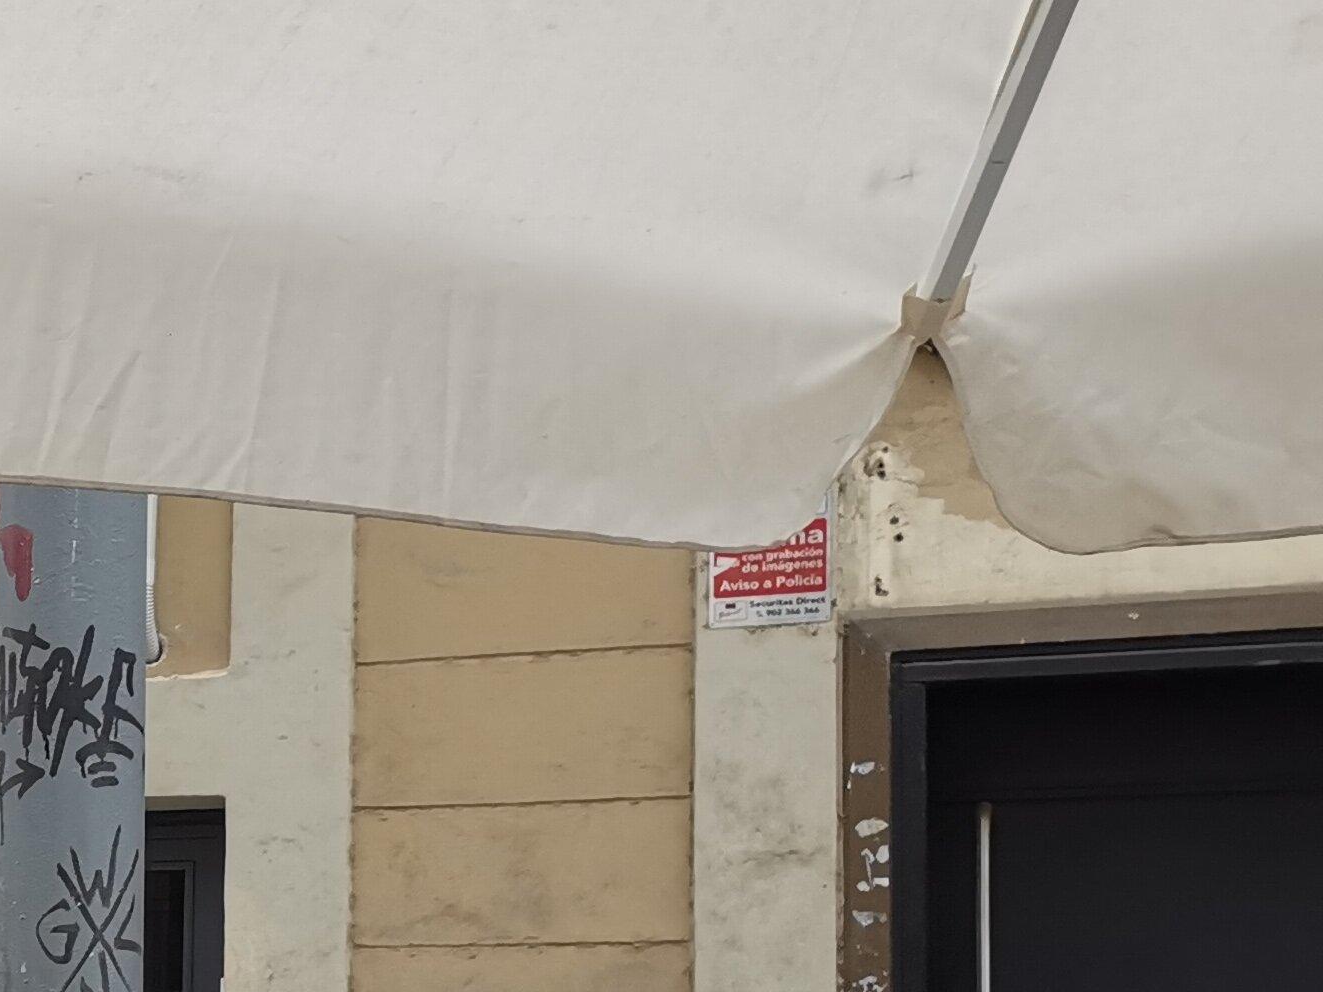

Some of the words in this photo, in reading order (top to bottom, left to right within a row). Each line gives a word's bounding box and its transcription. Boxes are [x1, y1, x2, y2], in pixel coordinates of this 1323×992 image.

[741, 562, 759, 573] de
[719, 579, 759, 592] Aviso
[763, 581, 772, 589] a
[776, 575, 823, 588] Policía
